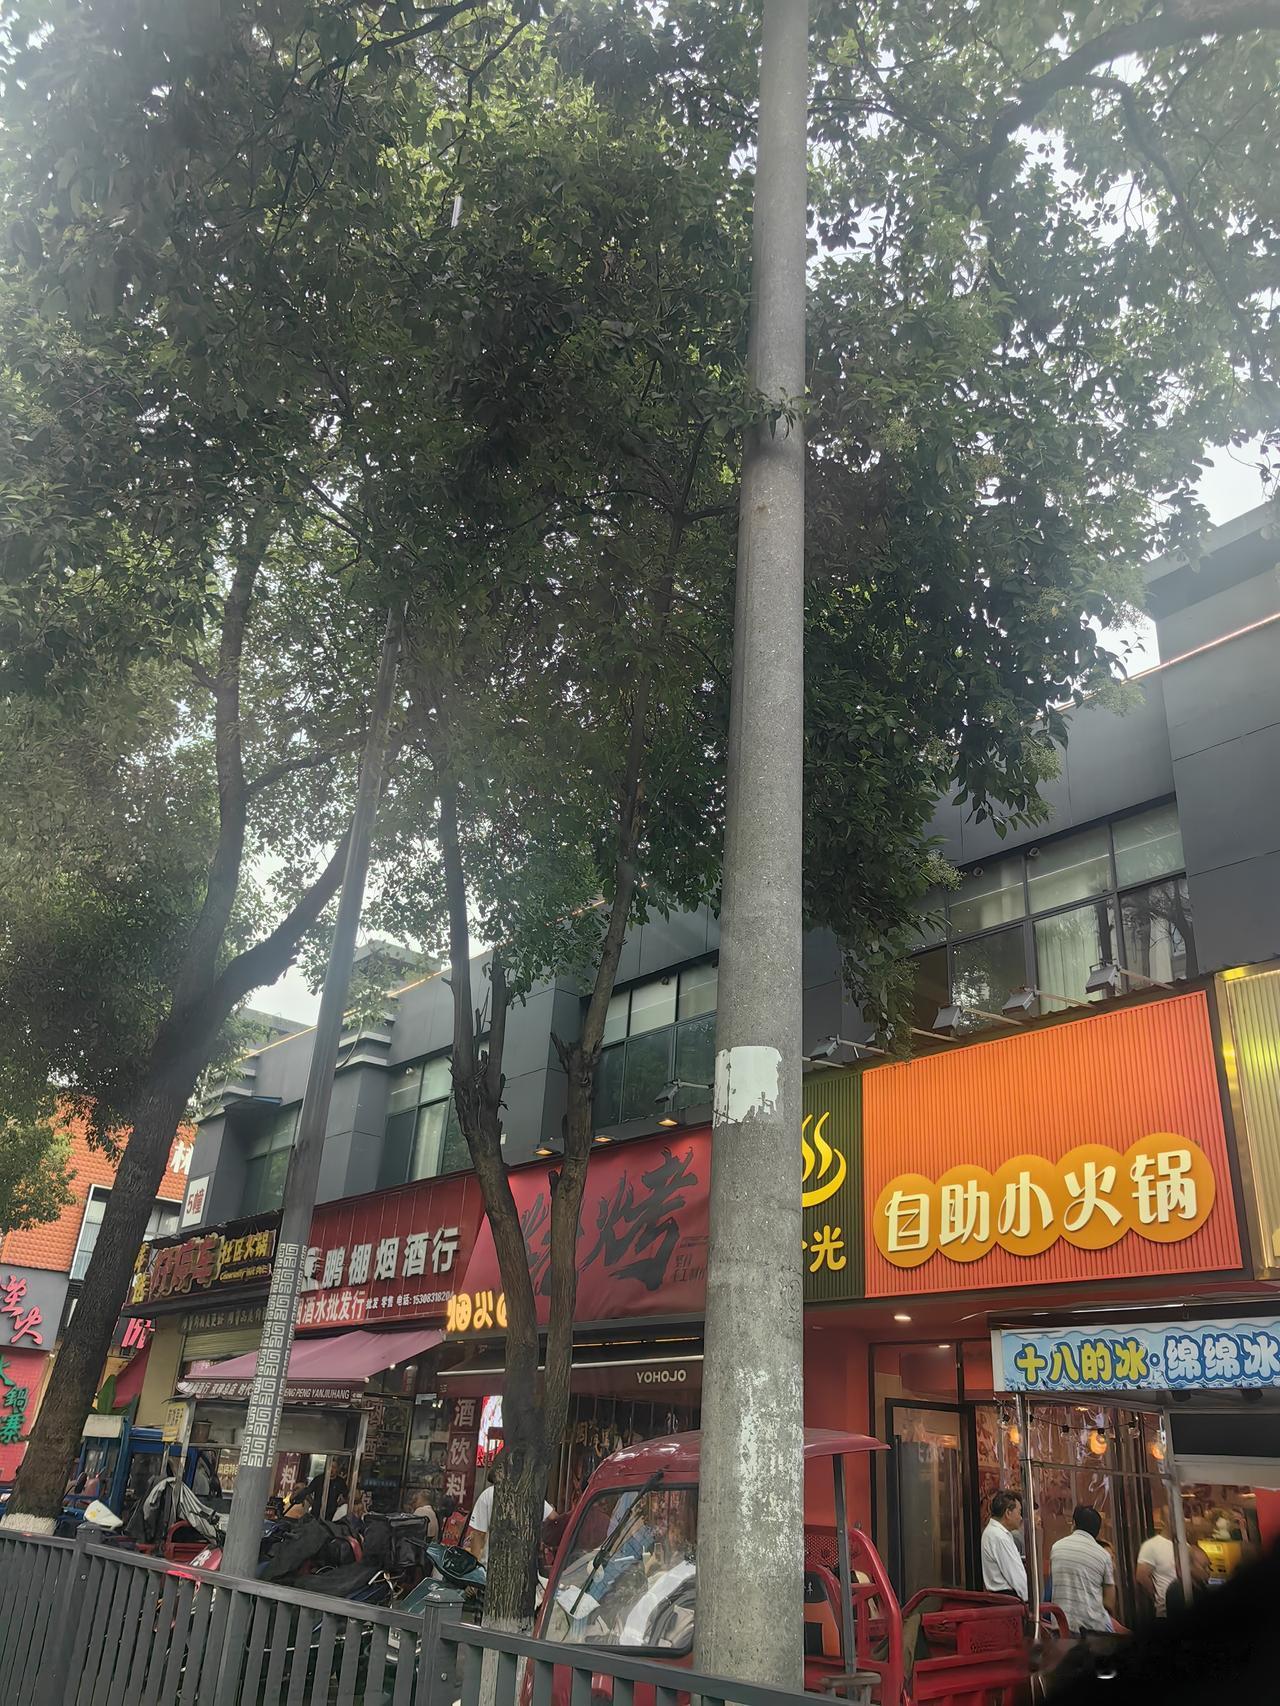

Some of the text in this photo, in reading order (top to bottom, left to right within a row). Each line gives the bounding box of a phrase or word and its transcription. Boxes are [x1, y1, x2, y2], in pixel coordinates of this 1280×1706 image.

[884, 1149, 1198, 1252] 自助小火锅
[802, 1225, 847, 1273] 光
[636, 1369, 686, 1383] YOHOJO
